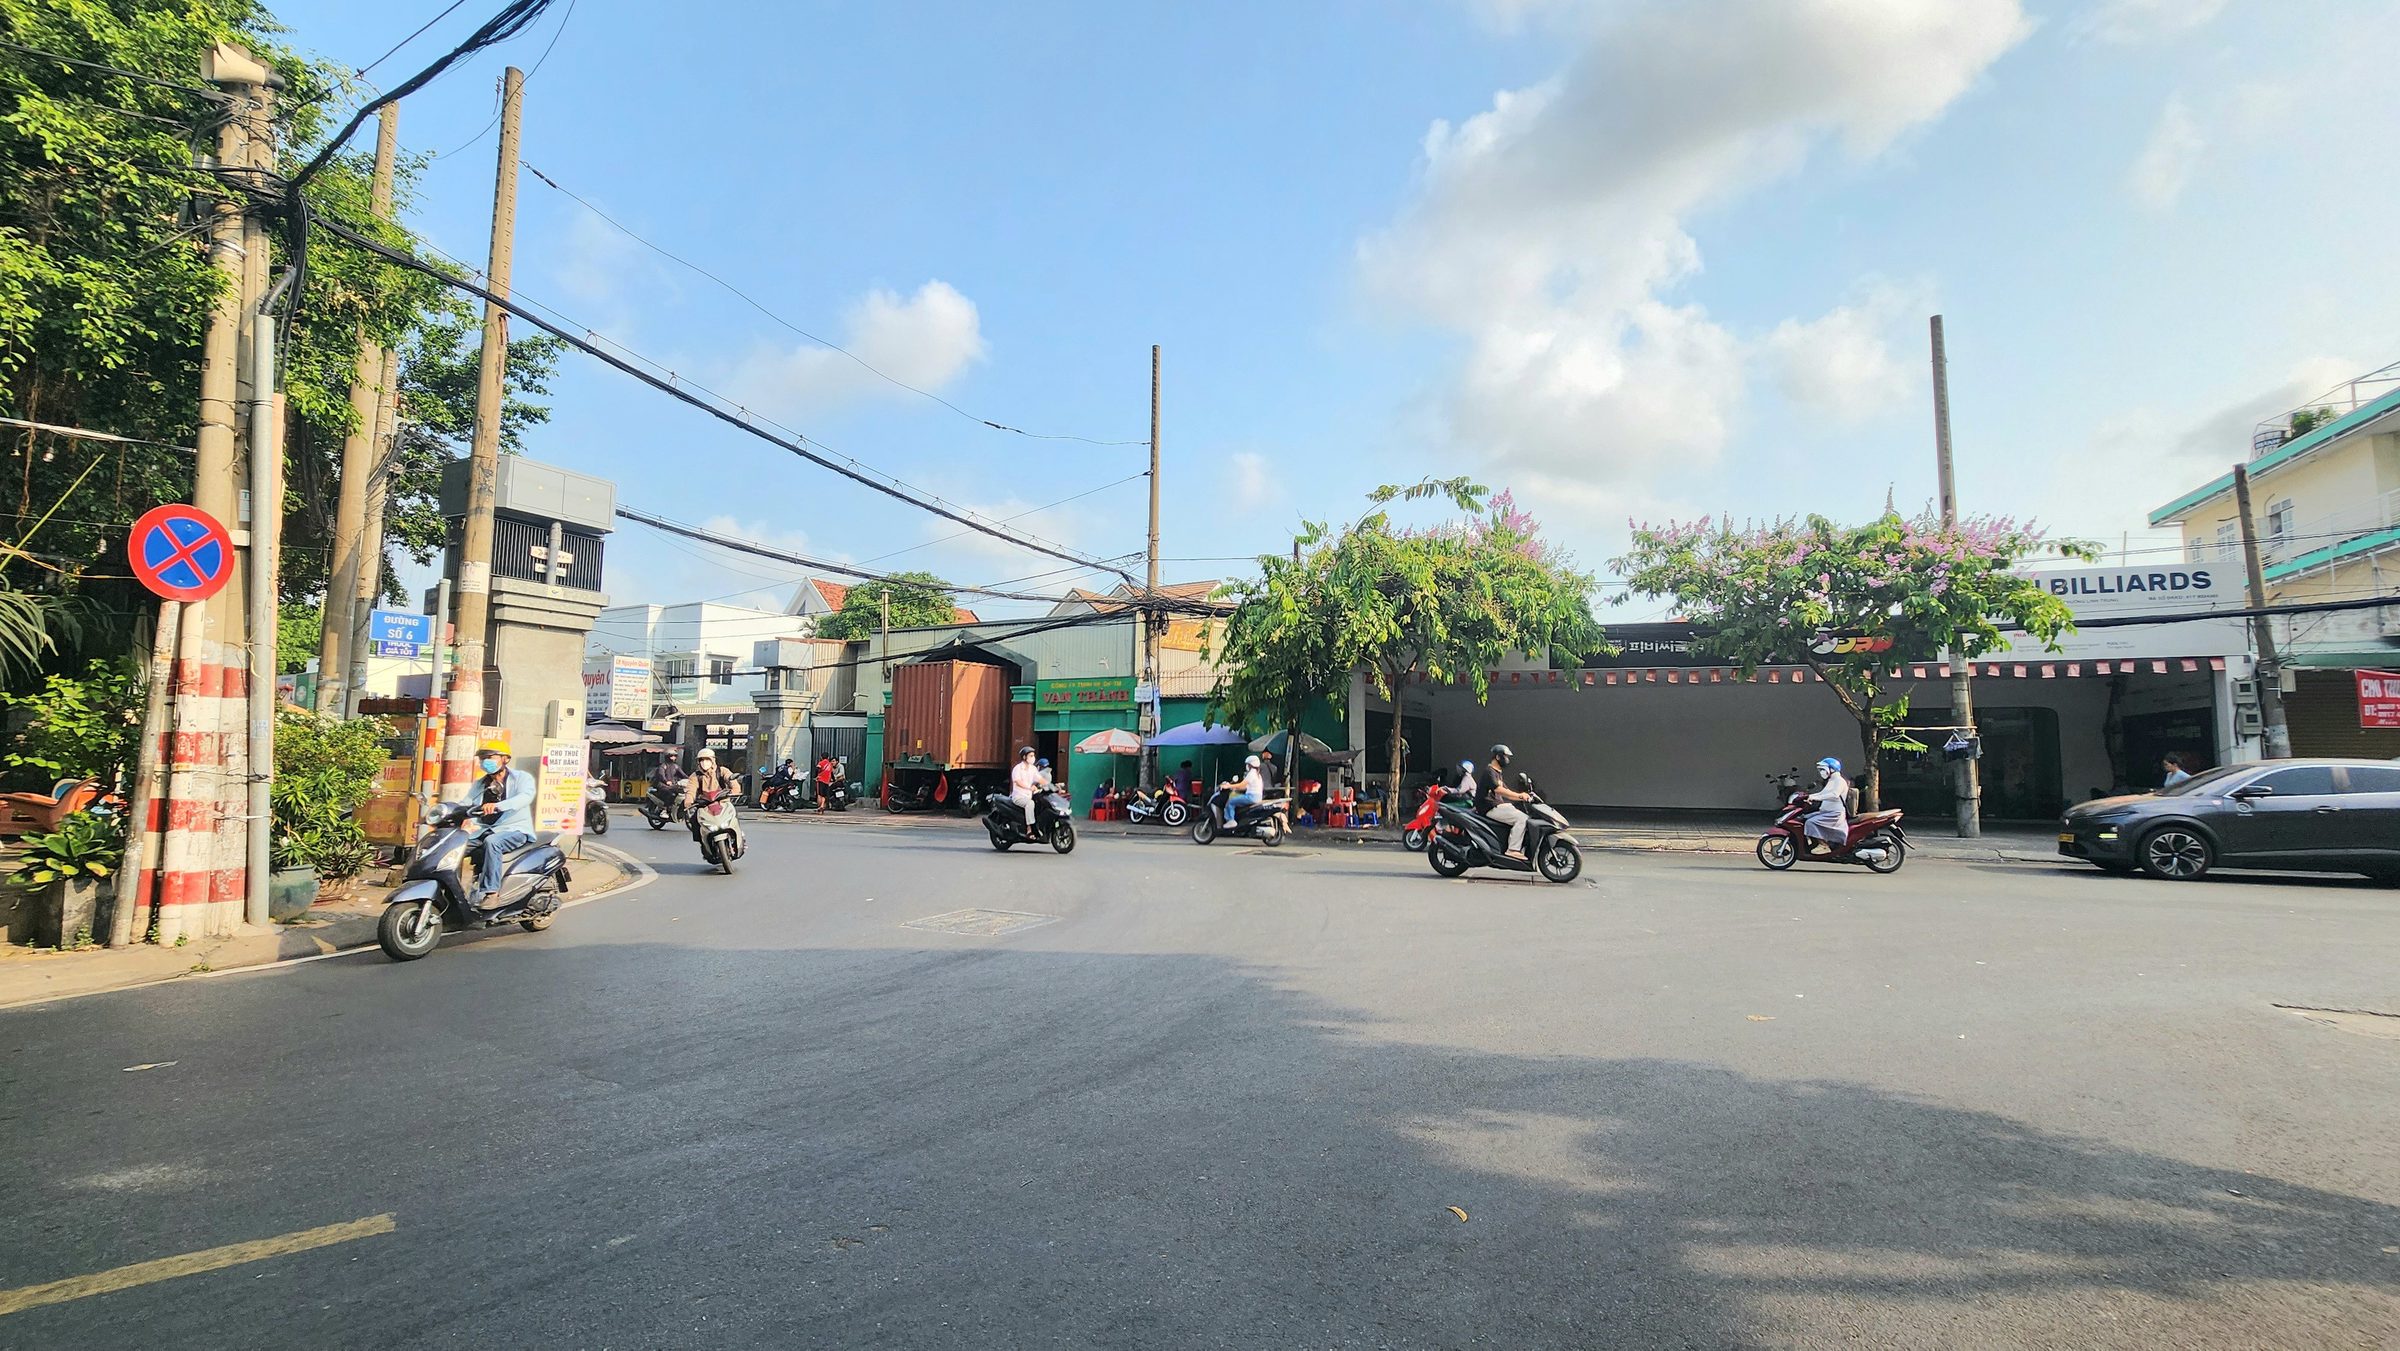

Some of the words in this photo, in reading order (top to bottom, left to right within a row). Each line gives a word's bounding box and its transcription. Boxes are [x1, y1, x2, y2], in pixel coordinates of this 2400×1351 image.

[2051, 571, 2212, 596] BILLIARDS
[384, 614, 419, 627] ĐƯỜNG
[388, 627, 404, 639] SỐ
[406, 630, 413, 640] 6
[550, 749, 562, 757] CHO
